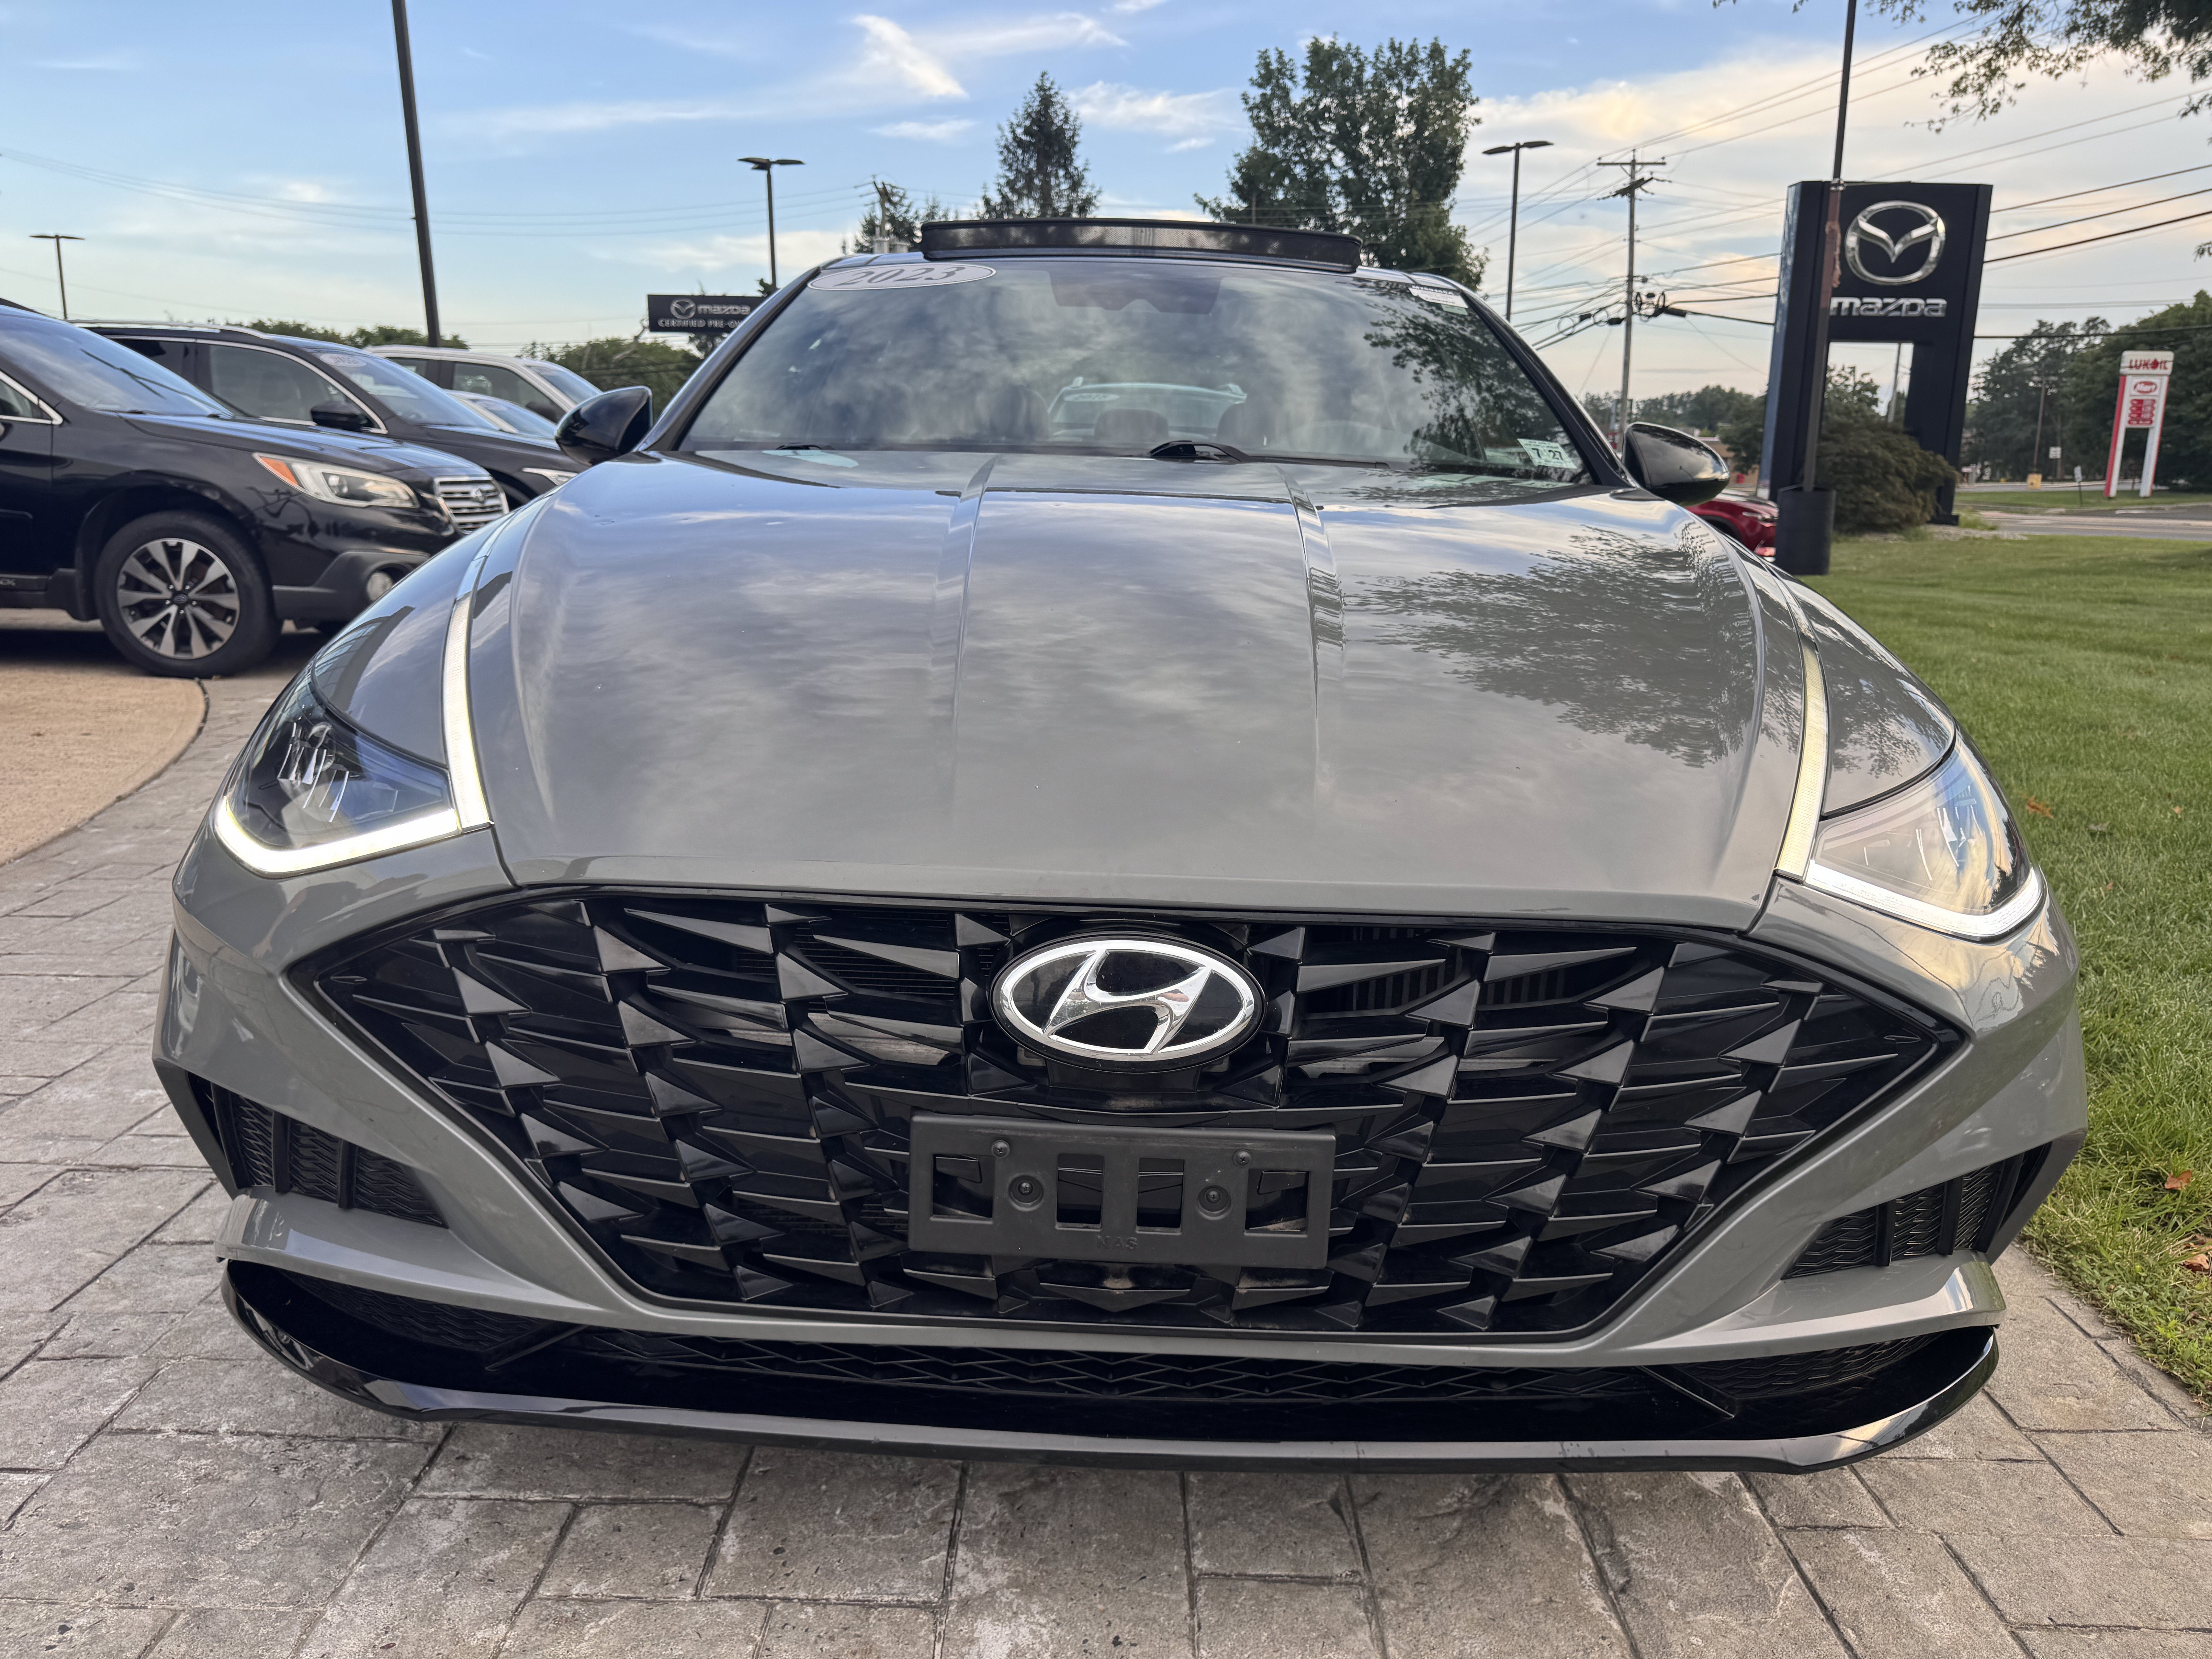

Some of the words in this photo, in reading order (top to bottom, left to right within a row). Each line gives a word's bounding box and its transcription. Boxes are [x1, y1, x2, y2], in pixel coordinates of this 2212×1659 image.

[833, 267, 965, 284] 2023
[658, 318, 706, 327] CERTIFIED
[2129, 359, 2168, 370] LUKOIL
[1531, 448, 1541, 458] 7
[1548, 450, 1564, 460] 27
